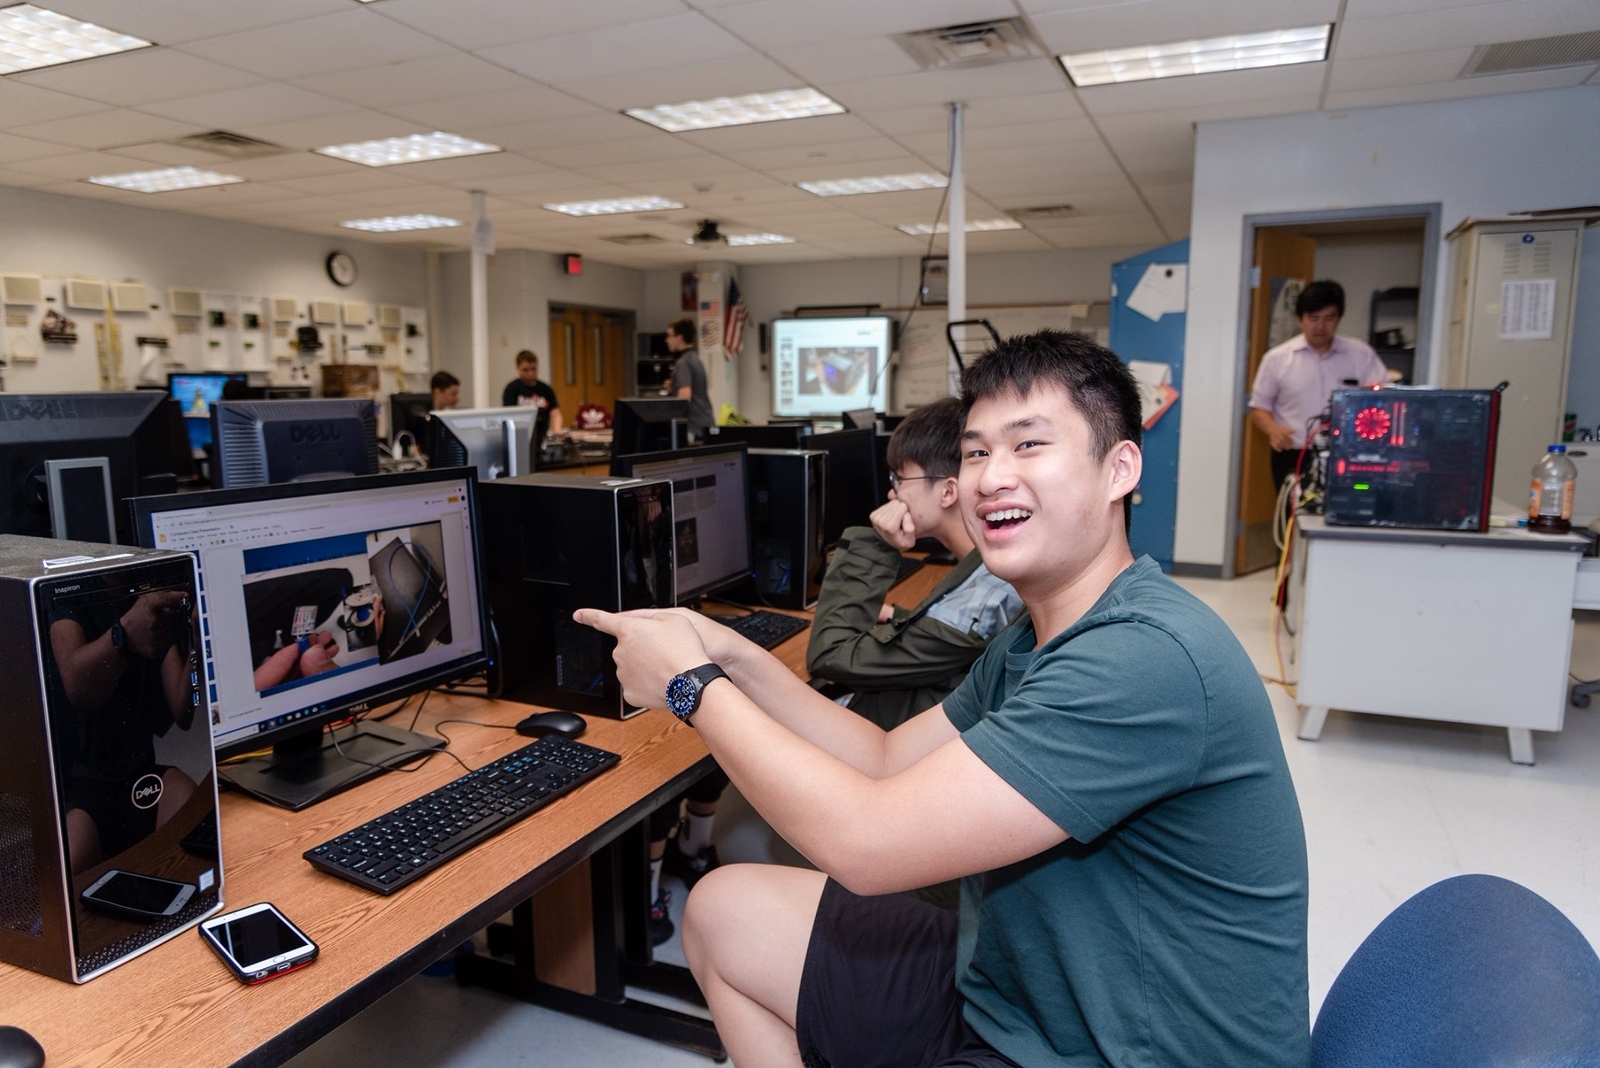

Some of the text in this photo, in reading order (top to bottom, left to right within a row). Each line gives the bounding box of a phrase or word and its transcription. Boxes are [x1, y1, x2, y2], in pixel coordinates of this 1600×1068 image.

[289, 424, 341, 443] DELL
[54, 585, 81, 594] Inspiron
[135, 784, 161, 800] DELL
